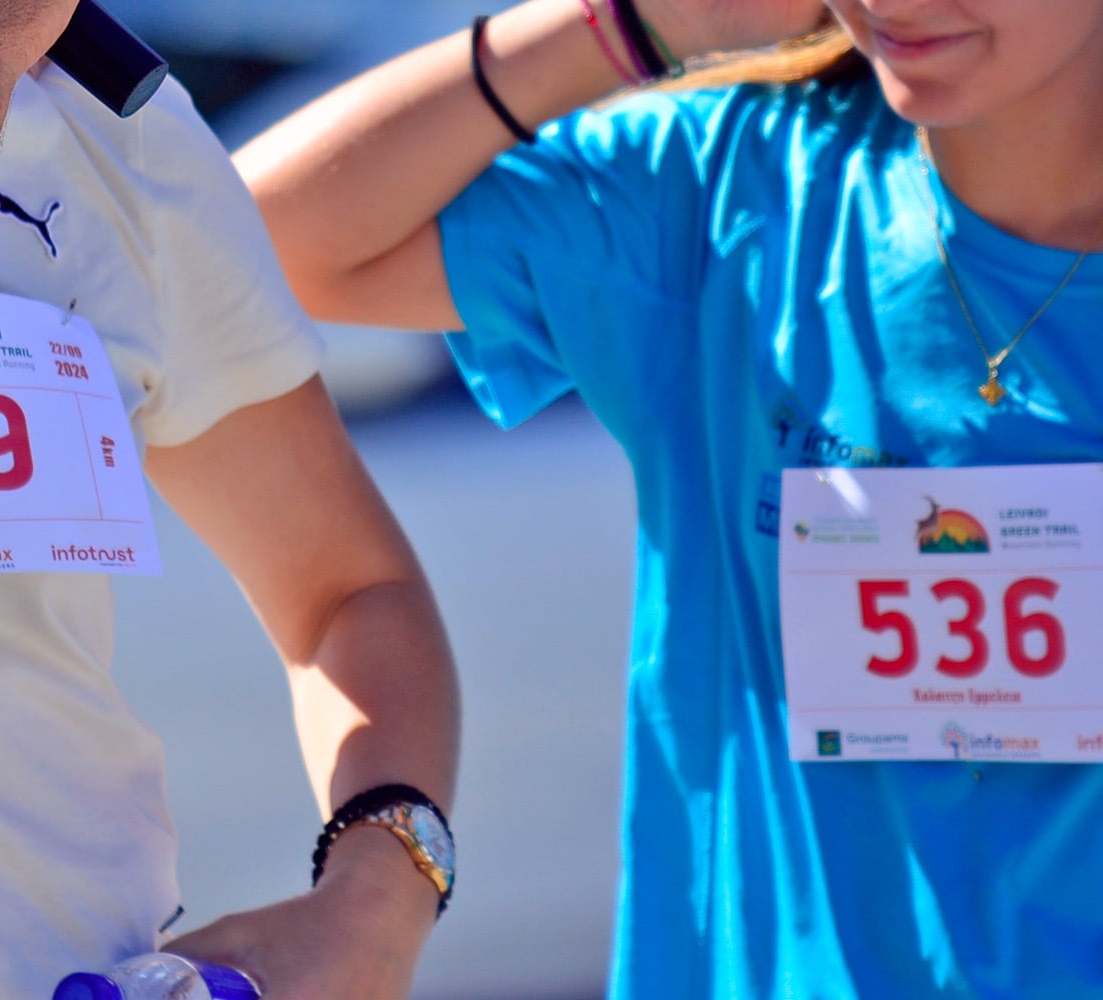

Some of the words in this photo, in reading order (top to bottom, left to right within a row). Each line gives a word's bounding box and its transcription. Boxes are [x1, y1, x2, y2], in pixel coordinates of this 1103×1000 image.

[0, 346, 33, 358] TRAIL
[48, 341, 82, 359] 22/09
[55, 360, 89, 380] 2024
[50, 544, 136, 562] infotrust
[858, 577, 1066, 679] 536
[969, 733, 1041, 750] infomax
